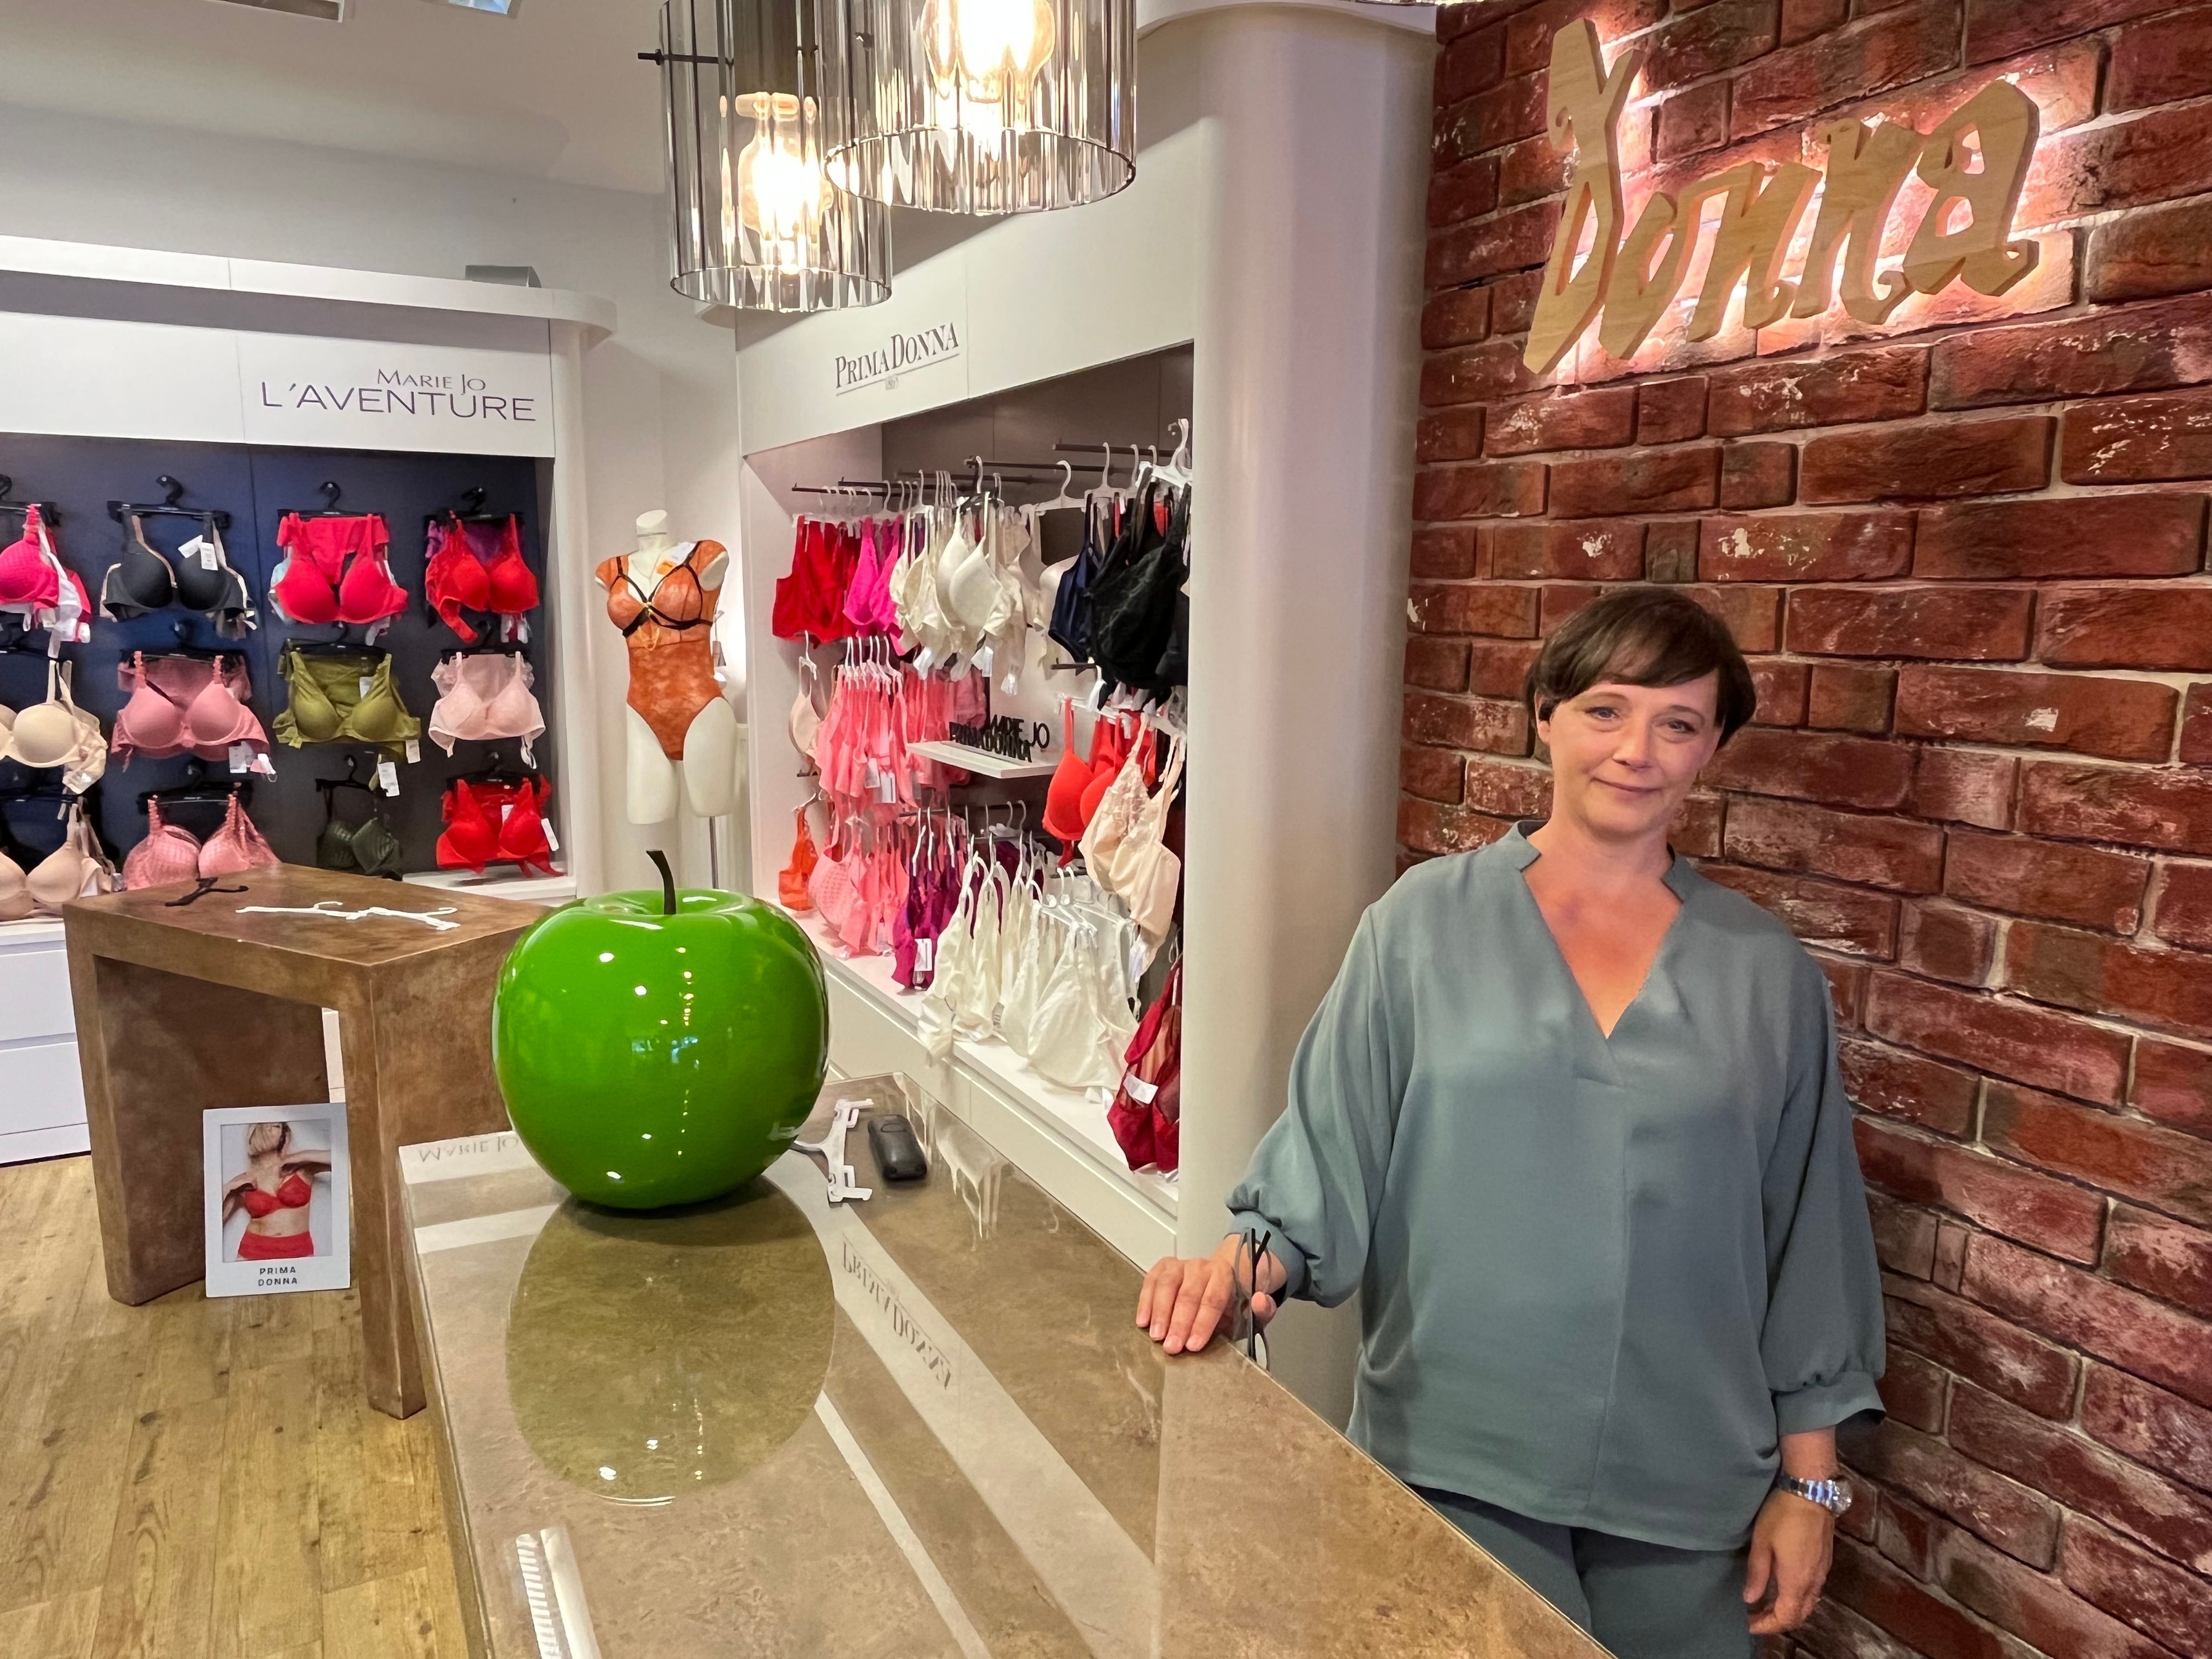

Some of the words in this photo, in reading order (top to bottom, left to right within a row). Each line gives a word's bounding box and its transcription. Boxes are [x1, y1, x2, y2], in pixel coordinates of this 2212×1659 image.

[1524, 18, 2039, 374] Donna
[377, 368, 453, 389] MARIE
[461, 374, 486, 395] JO
[262, 382, 536, 421] L'AVENTURE
[1029, 722, 1050, 748] JO
[258, 1277, 298, 1286] DONNA
[259, 1266, 296, 1275] PRIMA
